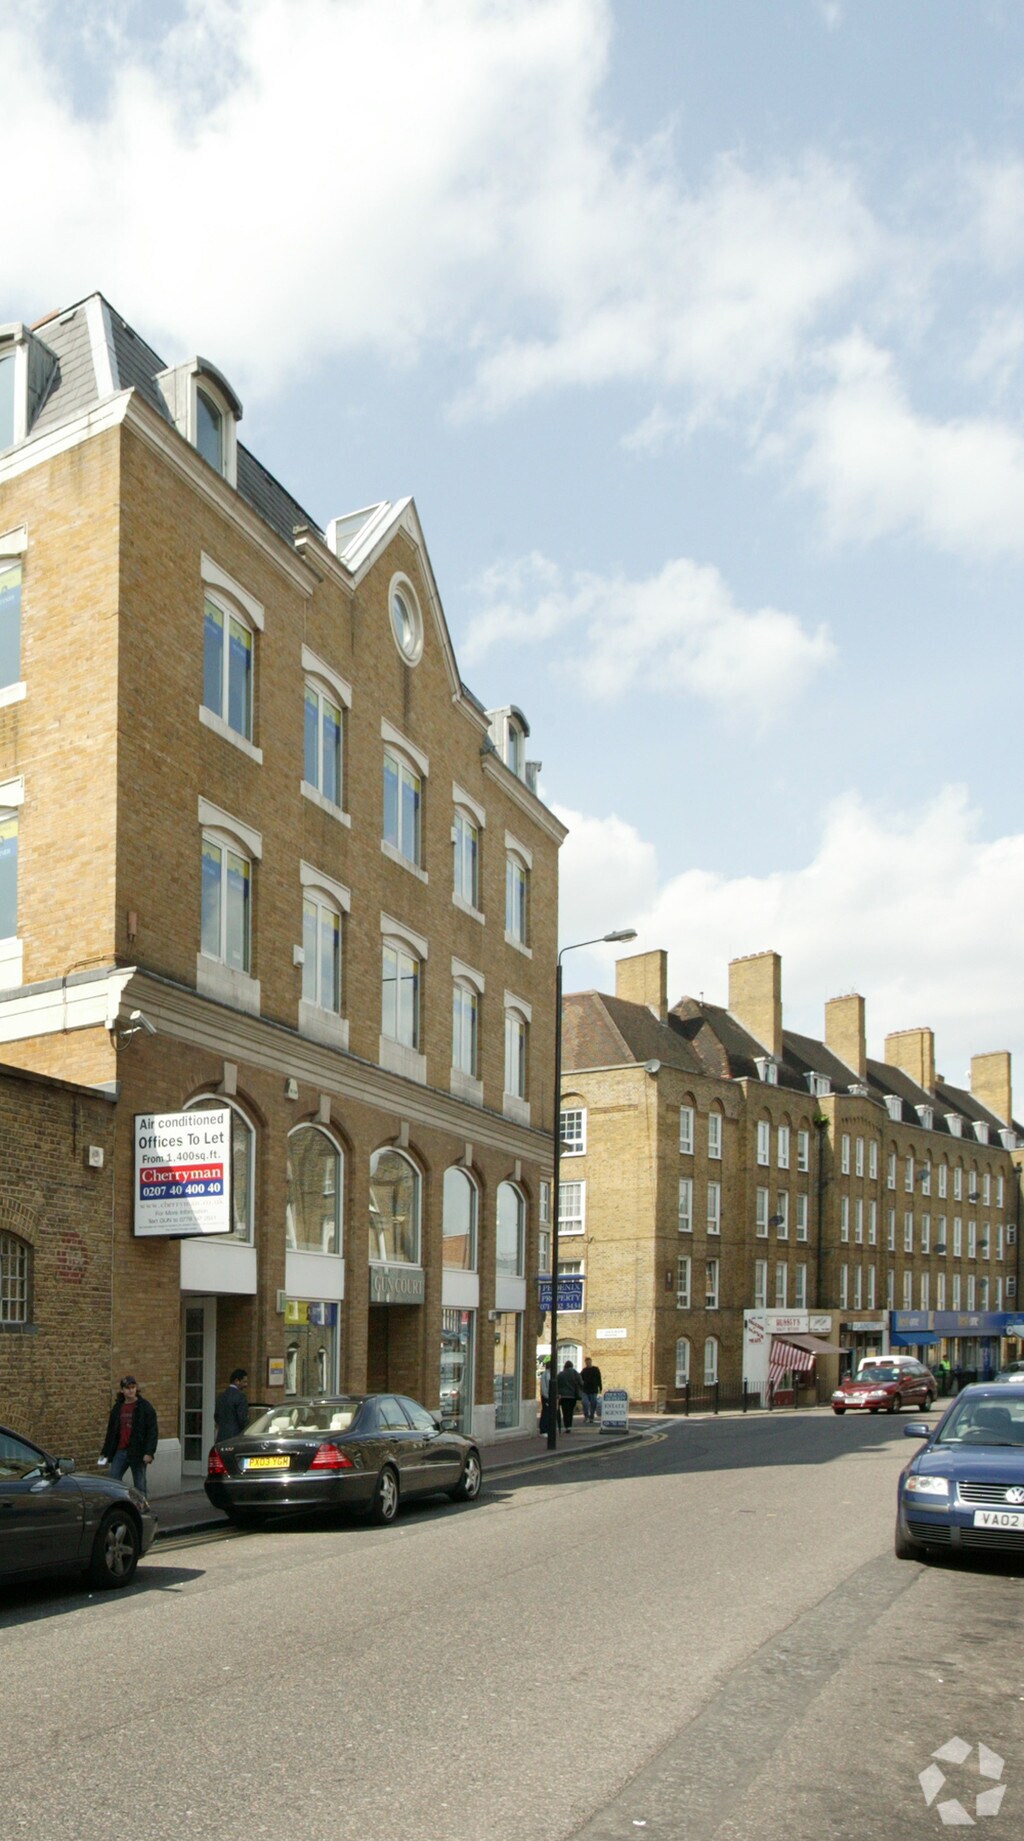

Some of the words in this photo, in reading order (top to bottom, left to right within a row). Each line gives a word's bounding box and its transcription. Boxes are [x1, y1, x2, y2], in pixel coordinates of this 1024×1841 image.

[139, 1118, 155, 1130] Air
[158, 1113, 224, 1128] conditioned
[138, 1135, 183, 1149] Offices
[187, 1133, 200, 1145] To
[204, 1131, 224, 1144] Let
[142, 1154, 164, 1163] From
[141, 1168, 221, 1183] Cherryman
[143, 1186, 167, 1197] 0207
[169, 1185, 182, 1195] 40
[185, 1183, 205, 1194] 400
[207, 1182, 221, 1193] 40
[374, 1275, 394, 1292] GUN
[395, 1278, 423, 1295] COURT
[542, 1283, 581, 1291] PHENIX
[541, 1294, 580, 1302] PRPERTY
[982, 1513, 1019, 1527] VA02
